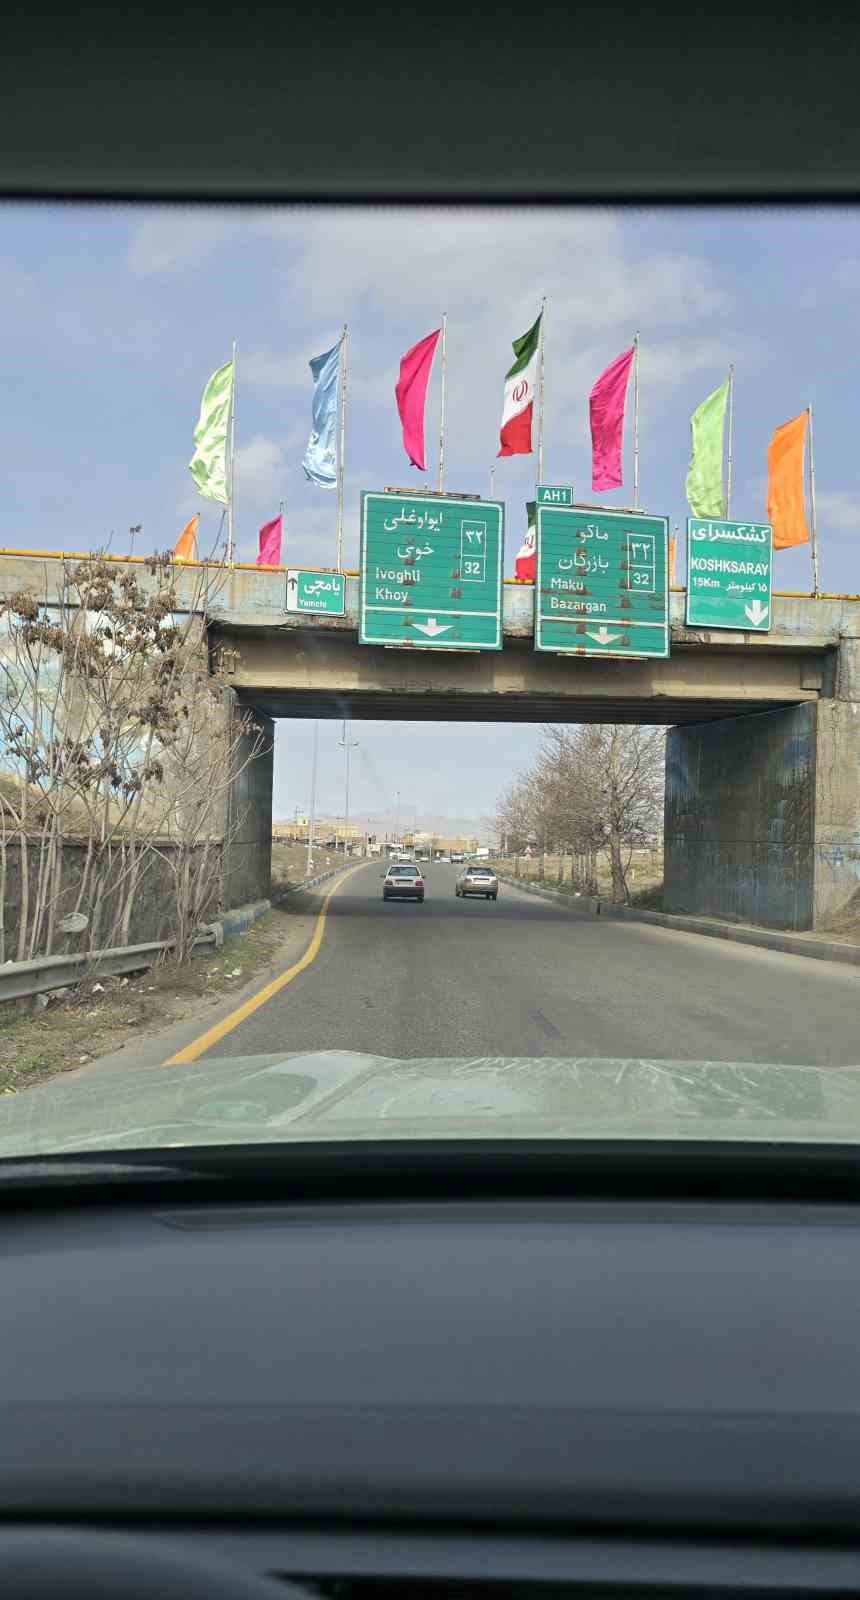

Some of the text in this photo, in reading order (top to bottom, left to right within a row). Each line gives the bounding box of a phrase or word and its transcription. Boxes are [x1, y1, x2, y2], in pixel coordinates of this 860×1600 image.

[543, 490, 567, 502] AH1
[383, 506, 443, 532] ایواوغلی
[465, 530, 483, 544] ۳۲
[579, 525, 609, 543] ماکو
[692, 523, 770, 543] کشکسرای
[397, 541, 435, 561] خوی
[631, 542, 650, 561] ۳۲
[464, 561, 481, 575] 32
[558, 551, 609, 574] بازرگان
[691, 557, 769, 577] KOSHKSARAY
[375, 567, 421, 584] Ivoghli
[550, 577, 584, 591] Maku
[632, 572, 650, 586] 32
[692, 577, 721, 589] 15Km
[303, 577, 341, 598] یامچی
[375, 587, 409, 602] Khoy
[726, 581, 757, 592] کیلومتر
[550, 597, 607, 614] Bazargan
